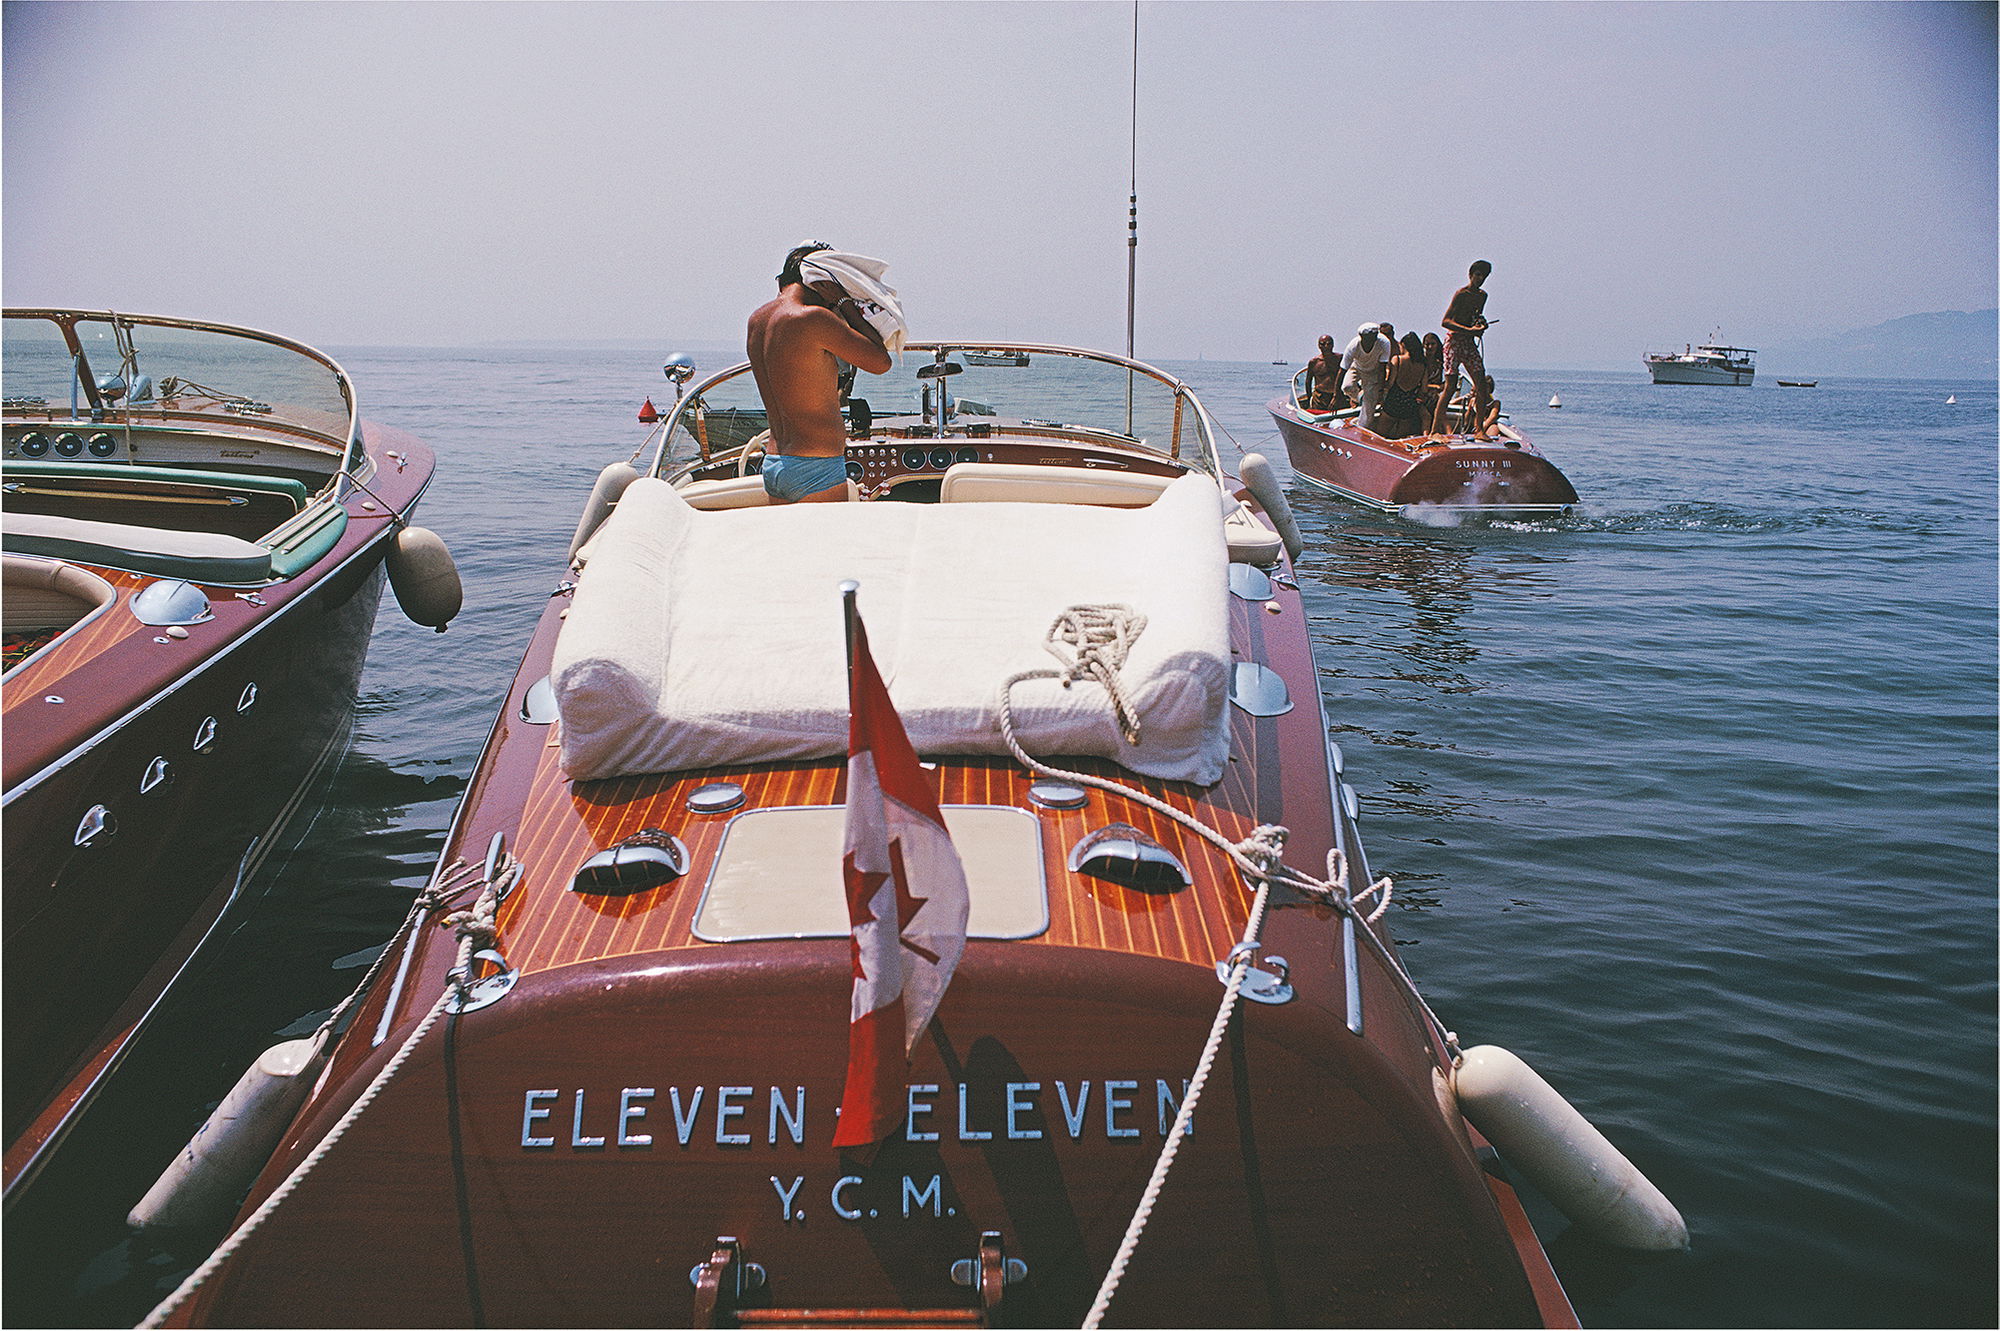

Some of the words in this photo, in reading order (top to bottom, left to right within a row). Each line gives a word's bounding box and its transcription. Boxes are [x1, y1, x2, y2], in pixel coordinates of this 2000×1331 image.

[1455, 460, 1495, 469] SUNNY
[1502, 460, 1512, 468] III
[521, 1085, 805, 1147] ELEVEN
[906, 1079, 1193, 1142] ELEVEN
